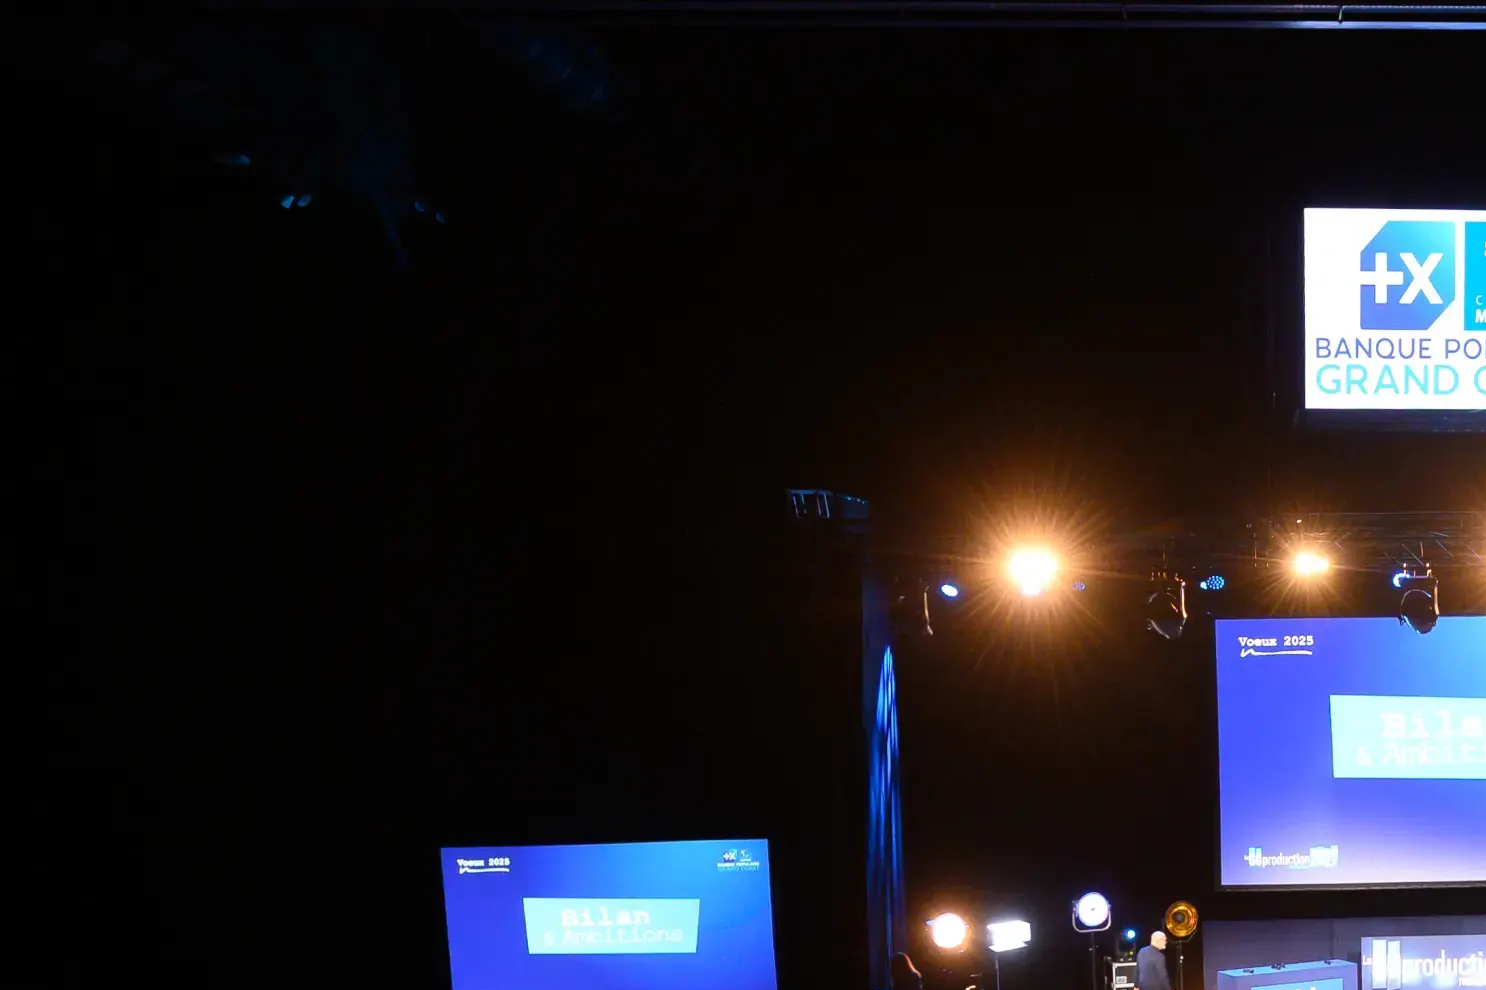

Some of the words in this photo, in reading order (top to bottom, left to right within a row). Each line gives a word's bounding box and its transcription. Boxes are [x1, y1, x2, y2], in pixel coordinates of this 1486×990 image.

[1315, 337, 1432, 360] BANQUE
[1315, 363, 1460, 396] GRAND
[1283, 635, 1314, 646] 2025
[559, 905, 651, 927] Bilan
